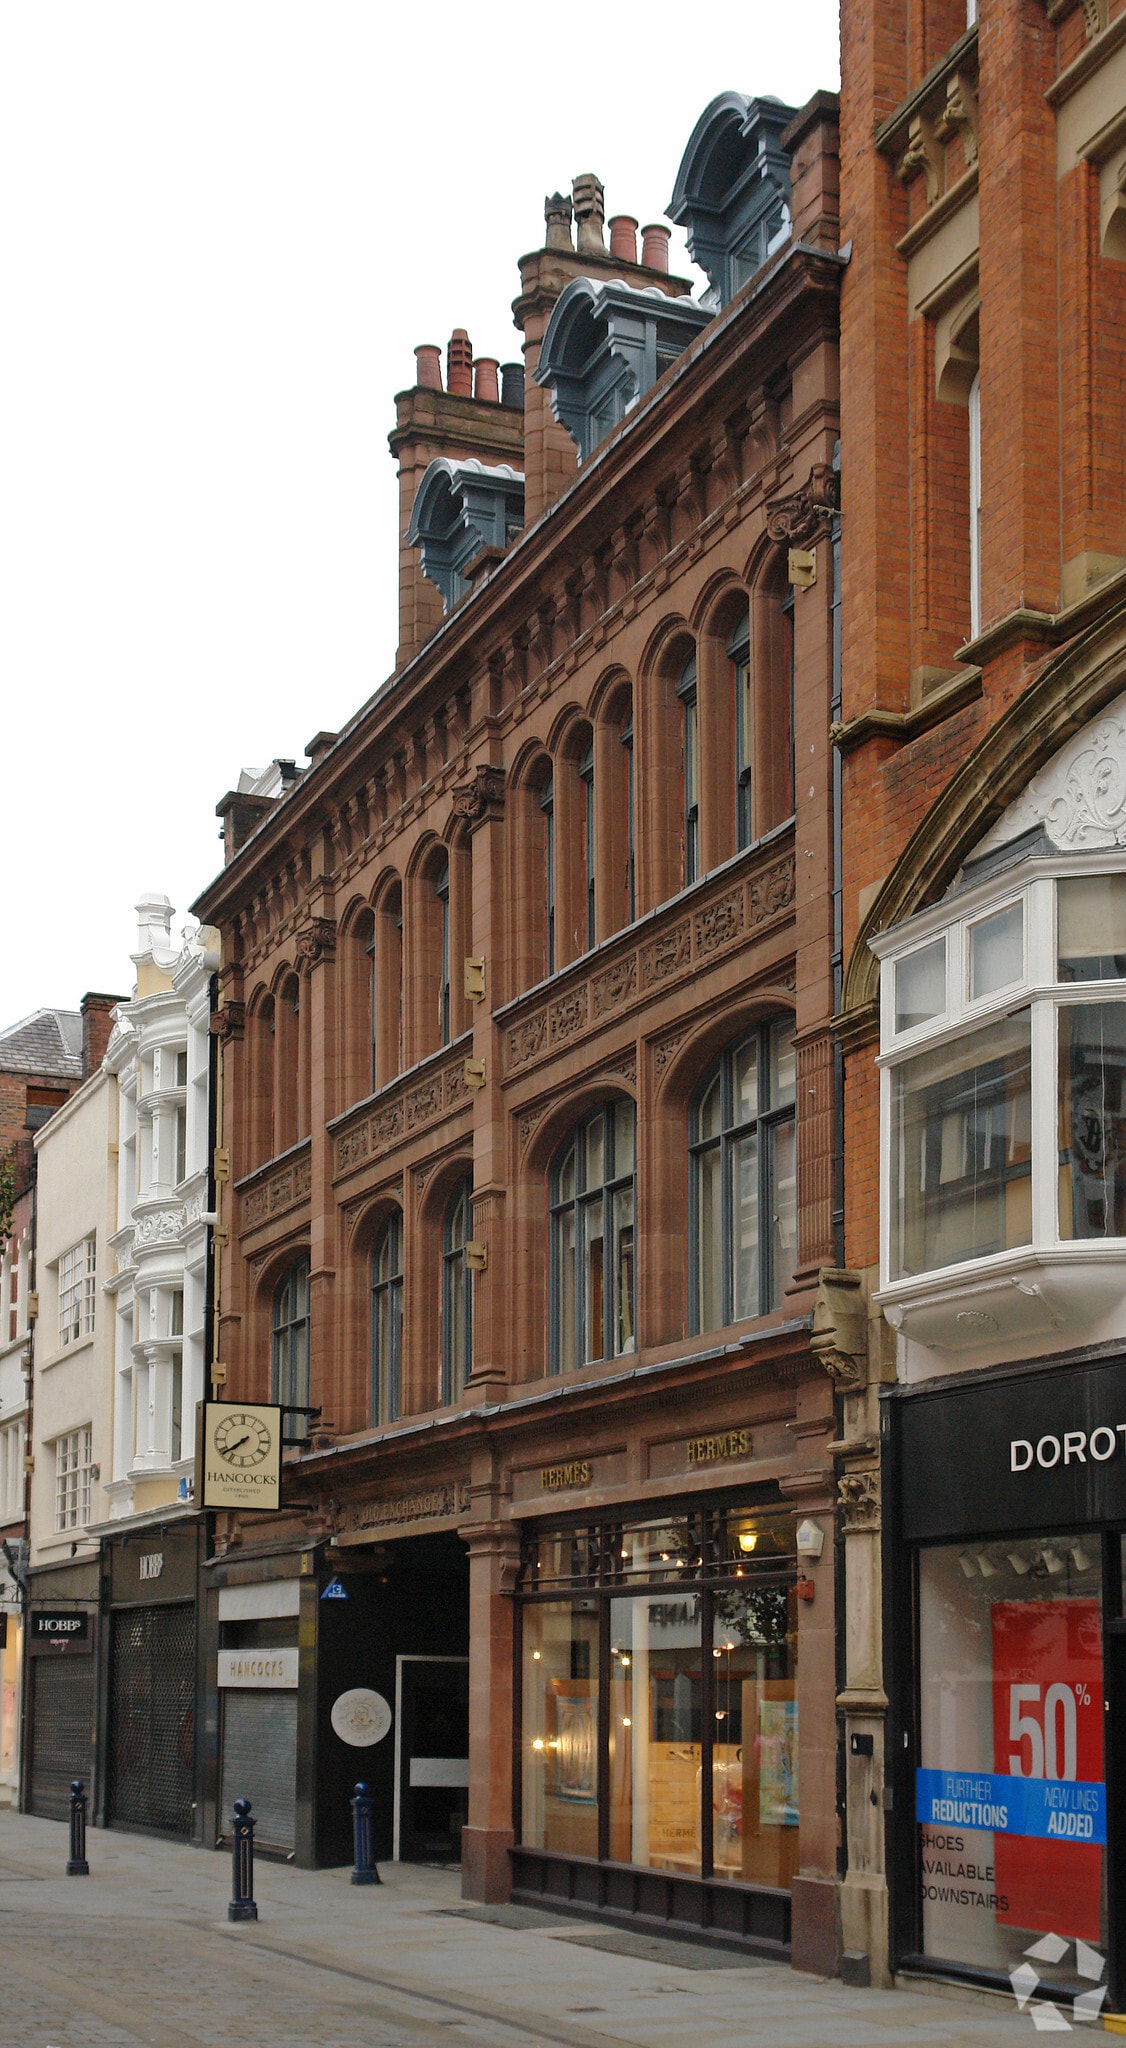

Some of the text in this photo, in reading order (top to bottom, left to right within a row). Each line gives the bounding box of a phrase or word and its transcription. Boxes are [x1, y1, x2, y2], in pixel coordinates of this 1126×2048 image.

[207, 1472, 277, 1485] HANCOCKS
[383, 1494, 438, 1517] EXCHANGE
[230, 1661, 284, 1678] HANCOCKS
[946, 1778, 992, 1800] FURTHER
[1044, 1787, 1099, 1812] NEW LINES
[931, 1798, 1008, 1829] REDUCTIONS
[1047, 1811, 1093, 1838] ADDED
